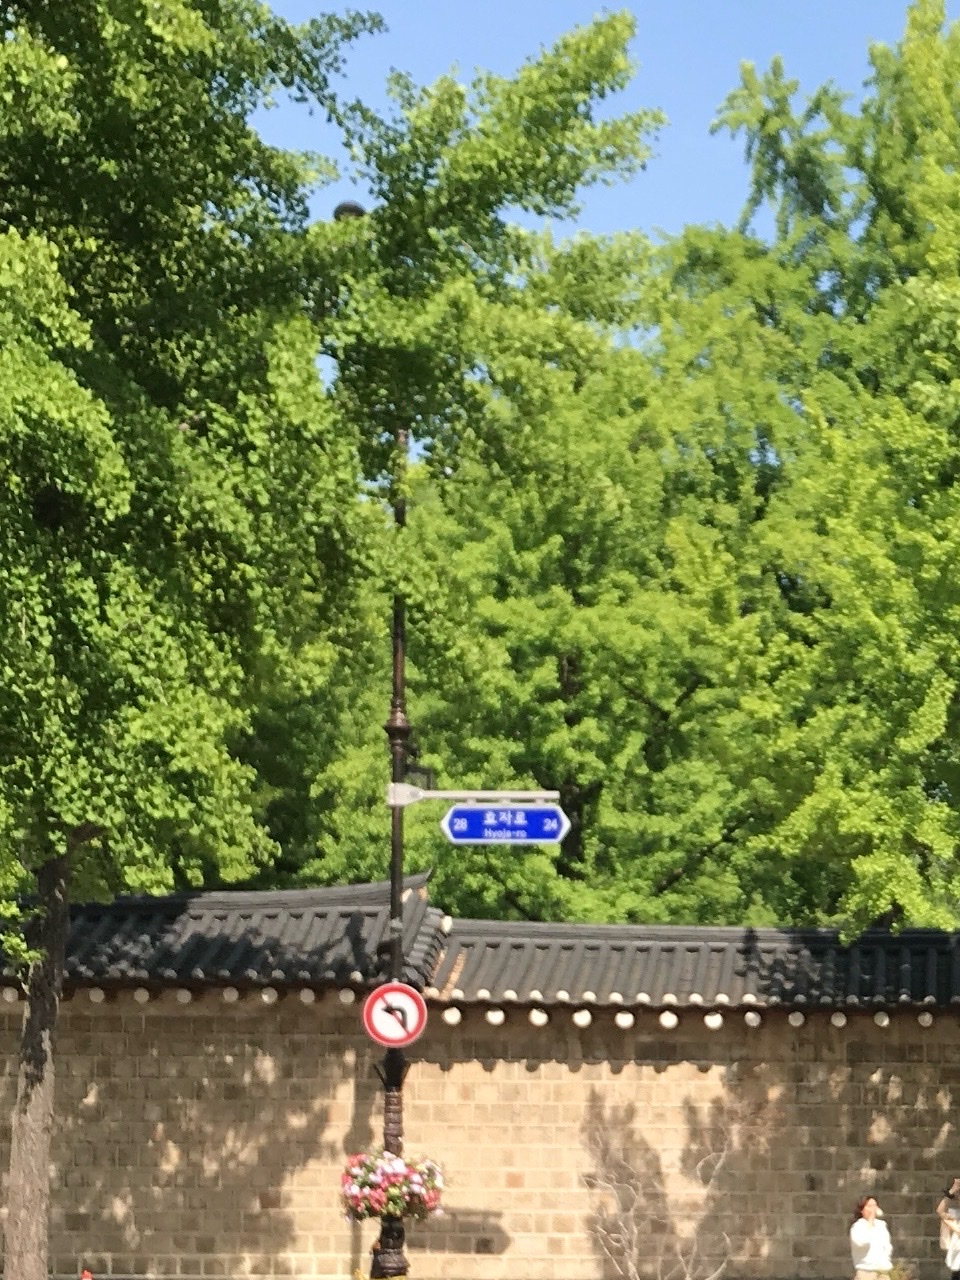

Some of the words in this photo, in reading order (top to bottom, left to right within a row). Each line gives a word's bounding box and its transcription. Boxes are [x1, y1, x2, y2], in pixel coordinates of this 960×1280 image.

[453, 818, 468, 831] 28
[484, 811, 528, 826] 효자로
[543, 818, 558, 831] 24
[484, 828, 527, 838] Hyoja-ro
